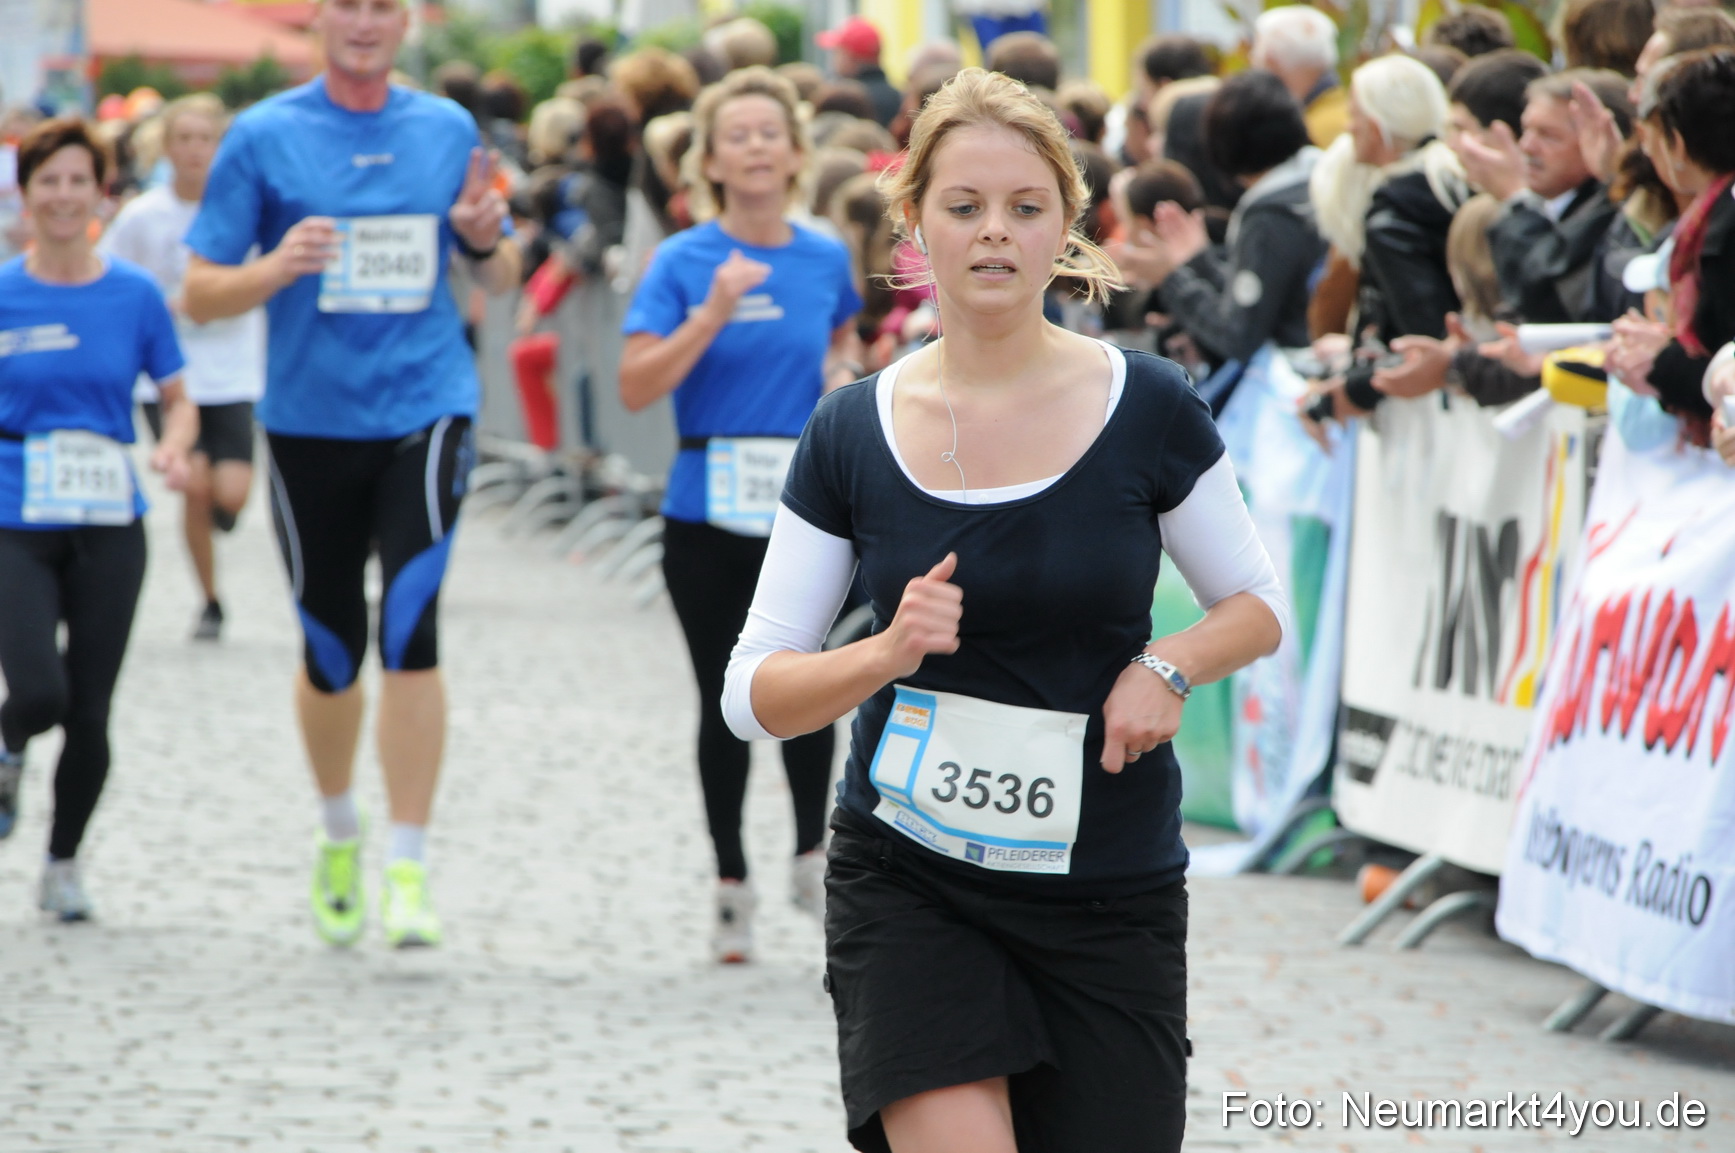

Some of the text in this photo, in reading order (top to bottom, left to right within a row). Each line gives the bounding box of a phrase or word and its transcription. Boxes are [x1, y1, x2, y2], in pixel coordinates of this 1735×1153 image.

[931, 761, 1056, 818] 3536
[988, 847, 1065, 863] PFLEIDERER
[1624, 839, 1712, 927] Radio
